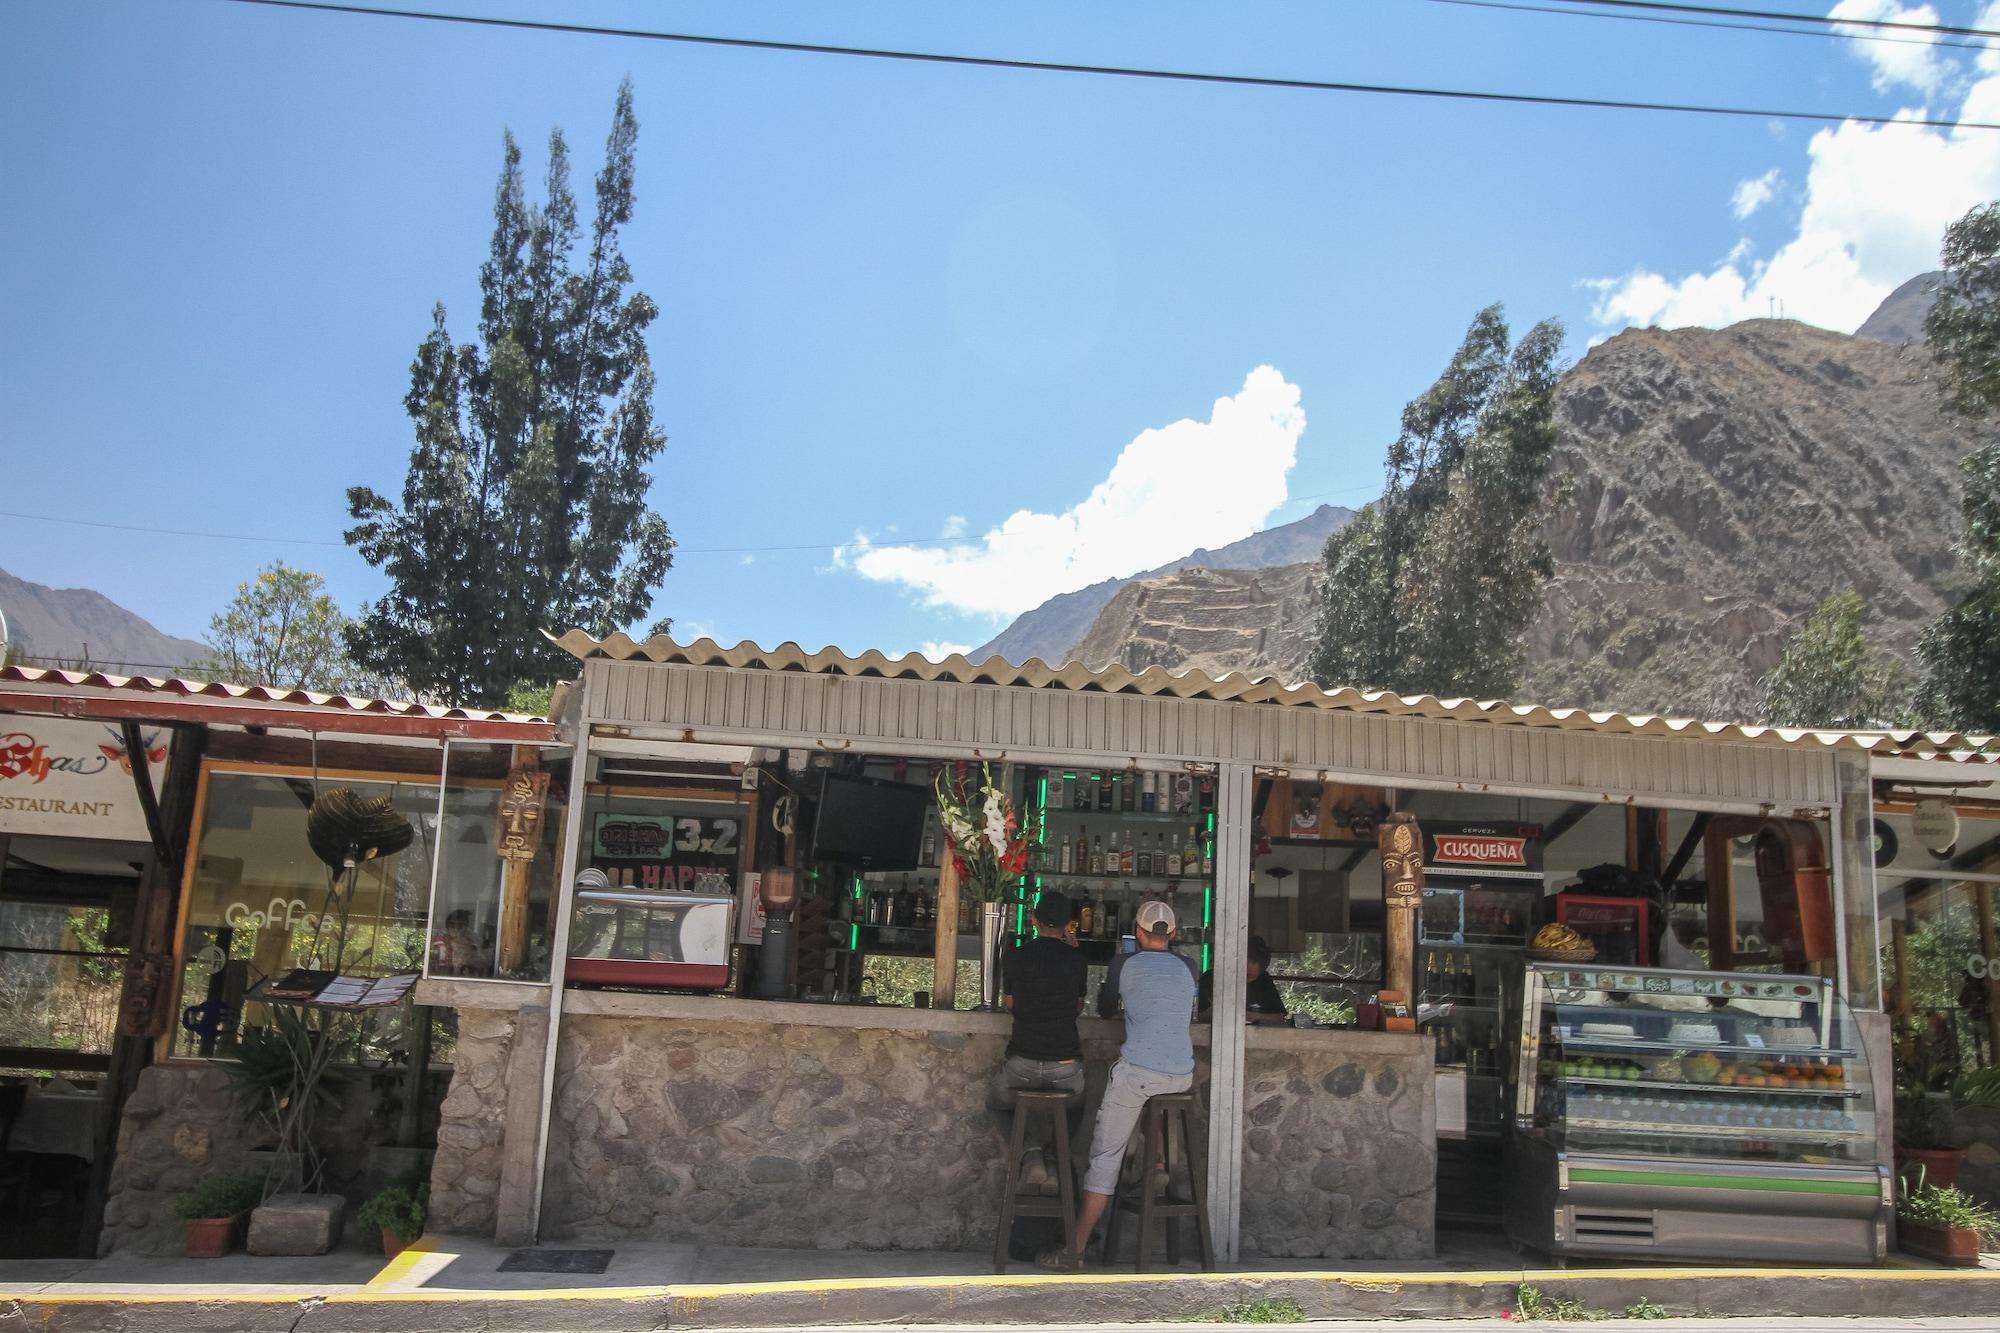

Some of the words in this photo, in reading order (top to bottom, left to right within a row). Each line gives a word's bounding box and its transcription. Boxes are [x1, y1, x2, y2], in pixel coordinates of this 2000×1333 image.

[1462, 827, 1497, 835] CERVEZA
[1443, 841, 1518, 860] CUSQUEÑA
[225, 897, 336, 933] Coffee
